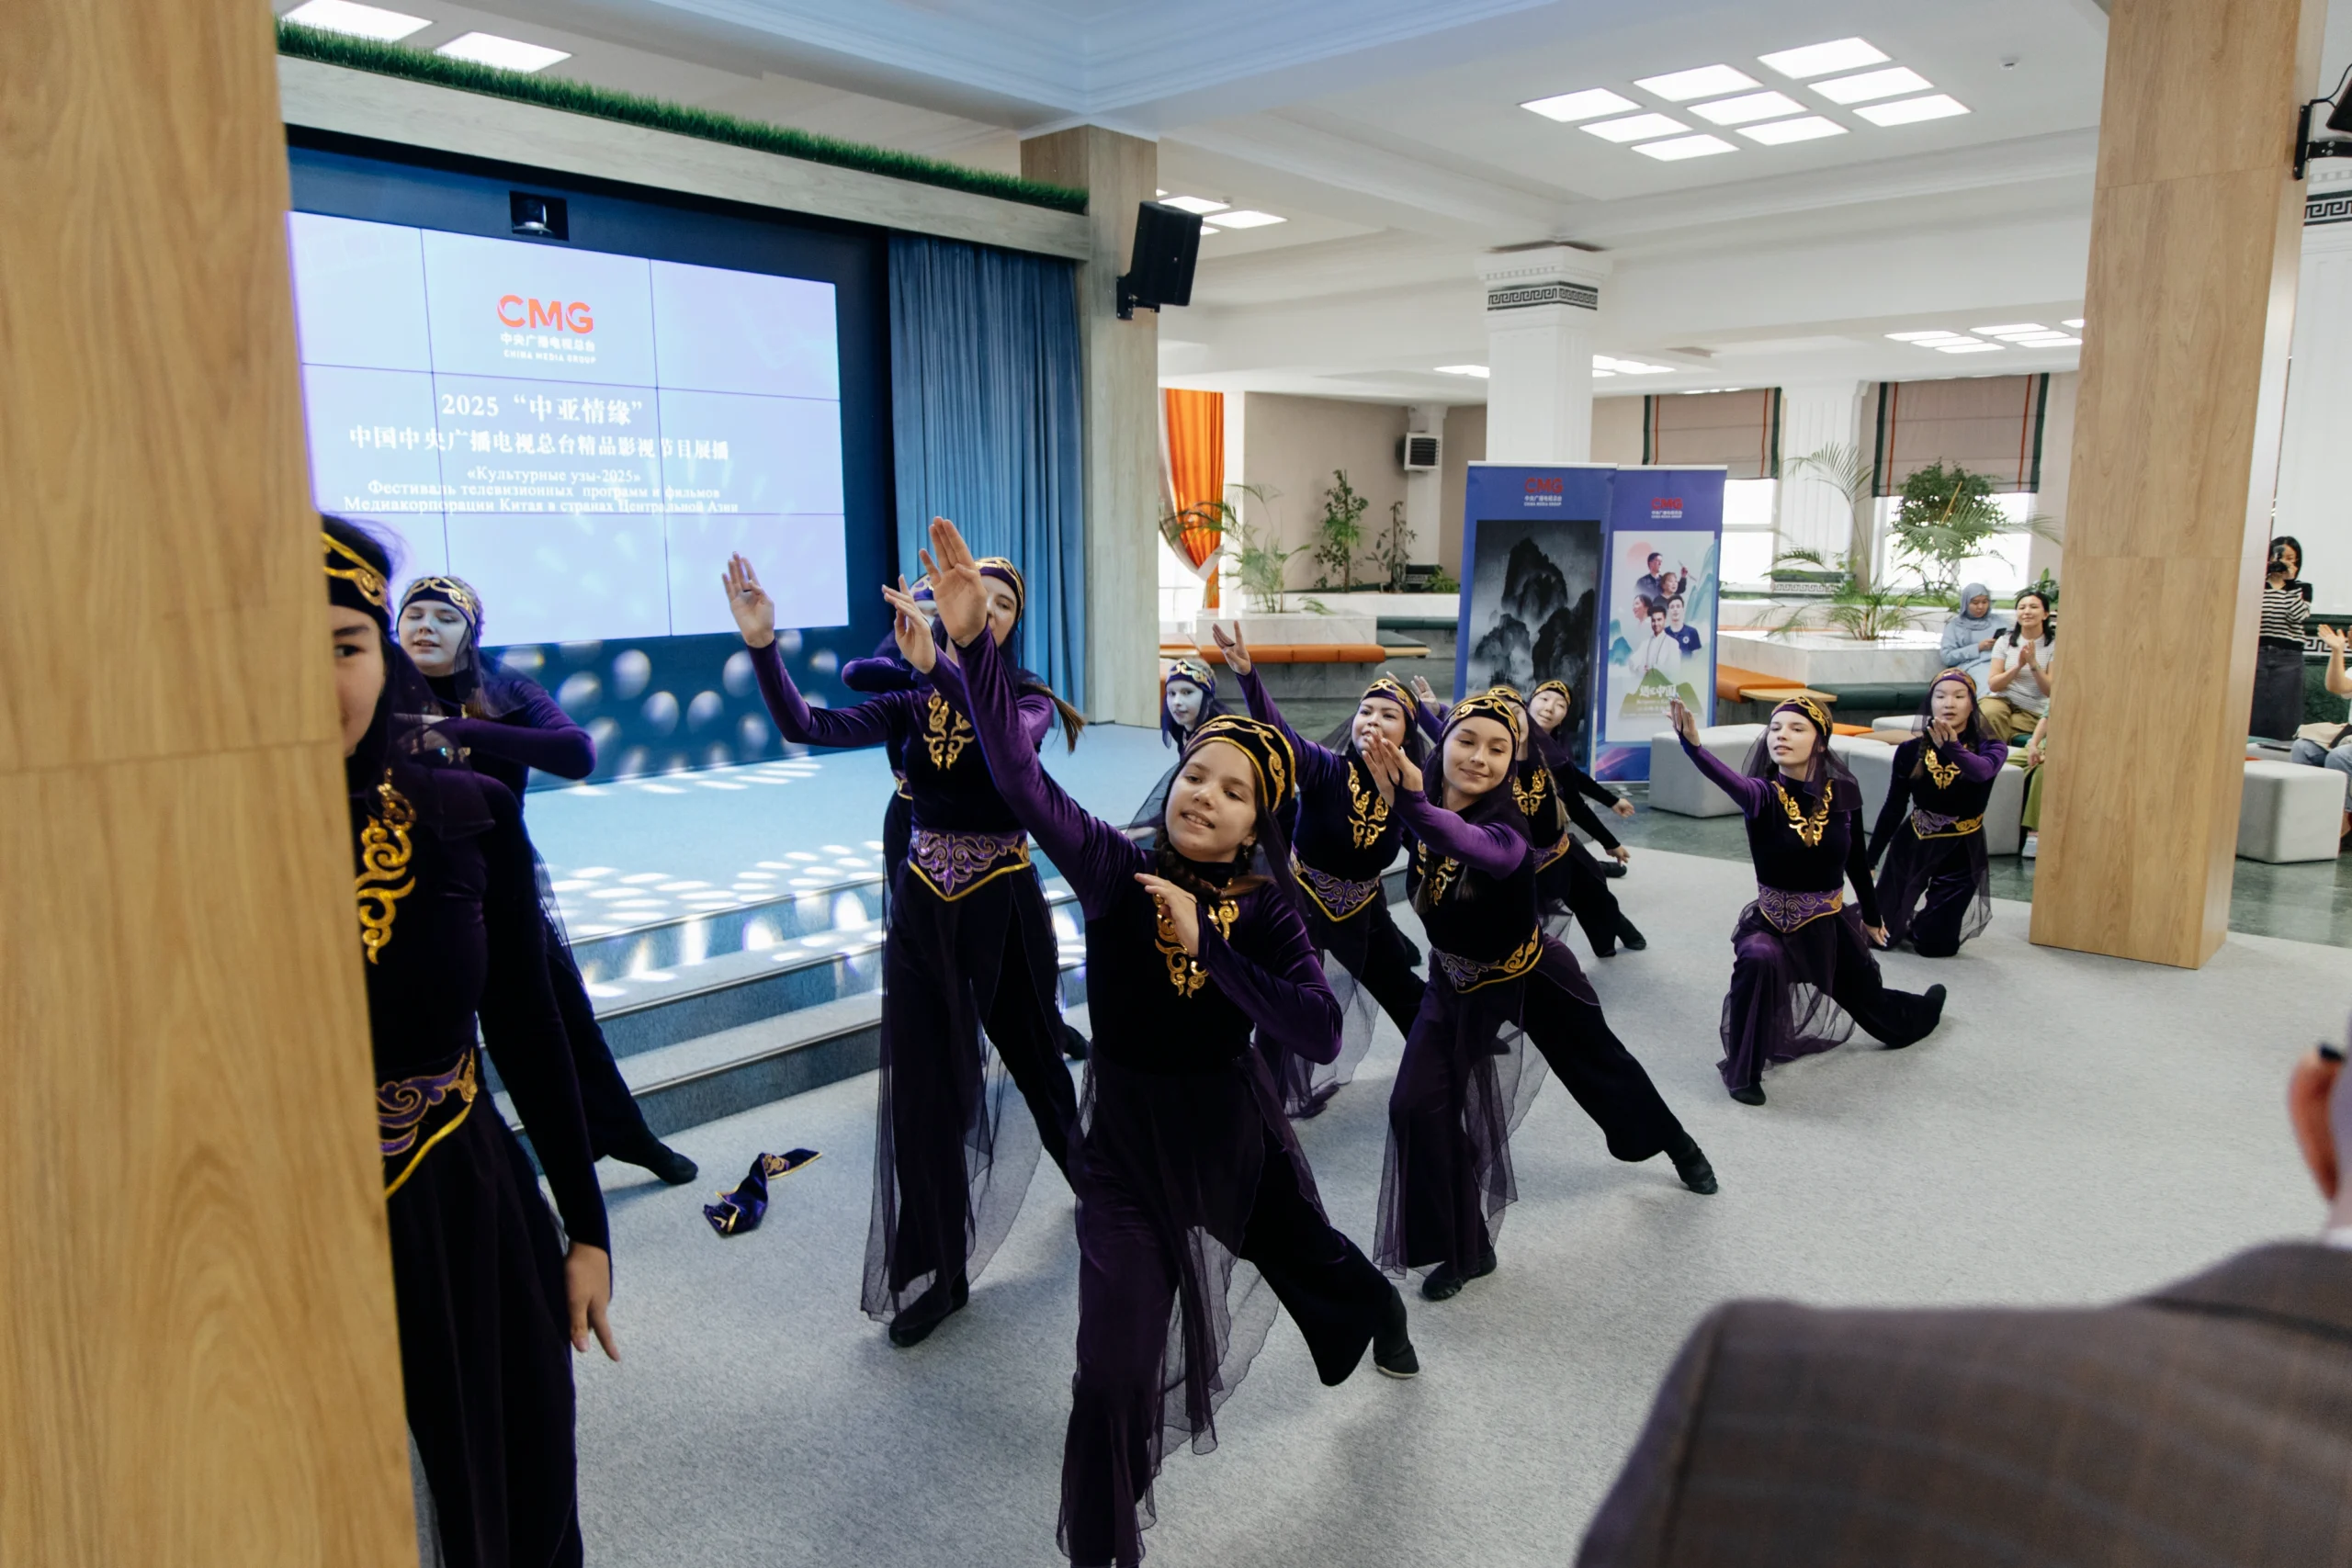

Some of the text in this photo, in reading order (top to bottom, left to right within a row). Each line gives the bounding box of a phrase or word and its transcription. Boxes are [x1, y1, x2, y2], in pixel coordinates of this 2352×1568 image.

[497, 294, 594, 334] CMG
[503, 349, 596, 364] CHINA MEDIA GROUP
[442, 394, 500, 417] 2025
[368, 479, 457, 495] Фестиваль
[460, 483, 573, 497] телевизионных
[582, 486, 648, 500] программ
[664, 484, 720, 501] фильмов
[1524, 477, 1564, 493] CMG
[344, 496, 494, 514] Медиакорпорации
[500, 498, 544, 512] Китая
[560, 501, 614, 515] странах
[707, 501, 739, 513] Азии
[1651, 497, 1683, 510] CMG
